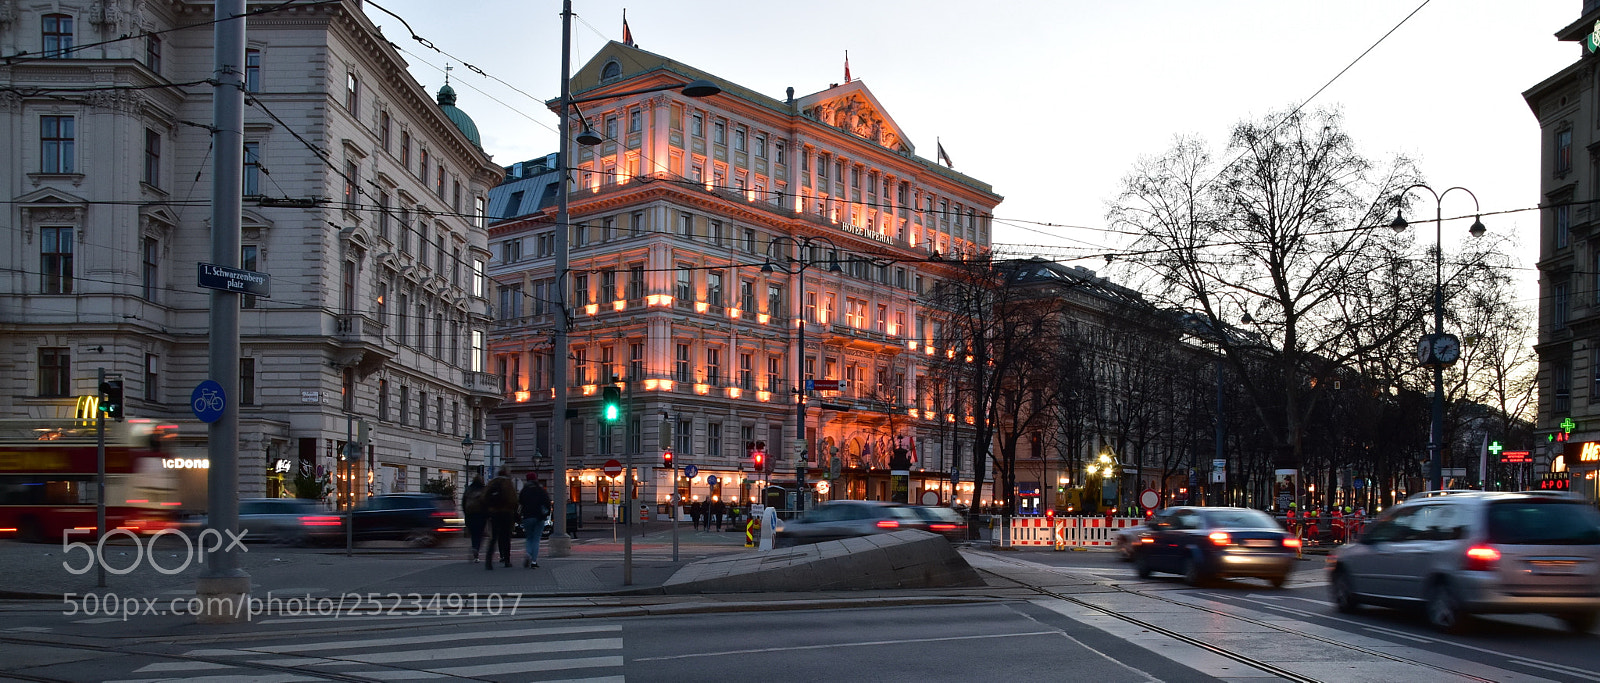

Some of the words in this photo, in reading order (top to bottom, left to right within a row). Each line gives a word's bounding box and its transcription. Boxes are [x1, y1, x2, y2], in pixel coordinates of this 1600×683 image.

[865, 228, 894, 245] IMPERIAL
[227, 279, 244, 289] platz
[162, 457, 210, 469] cDona
